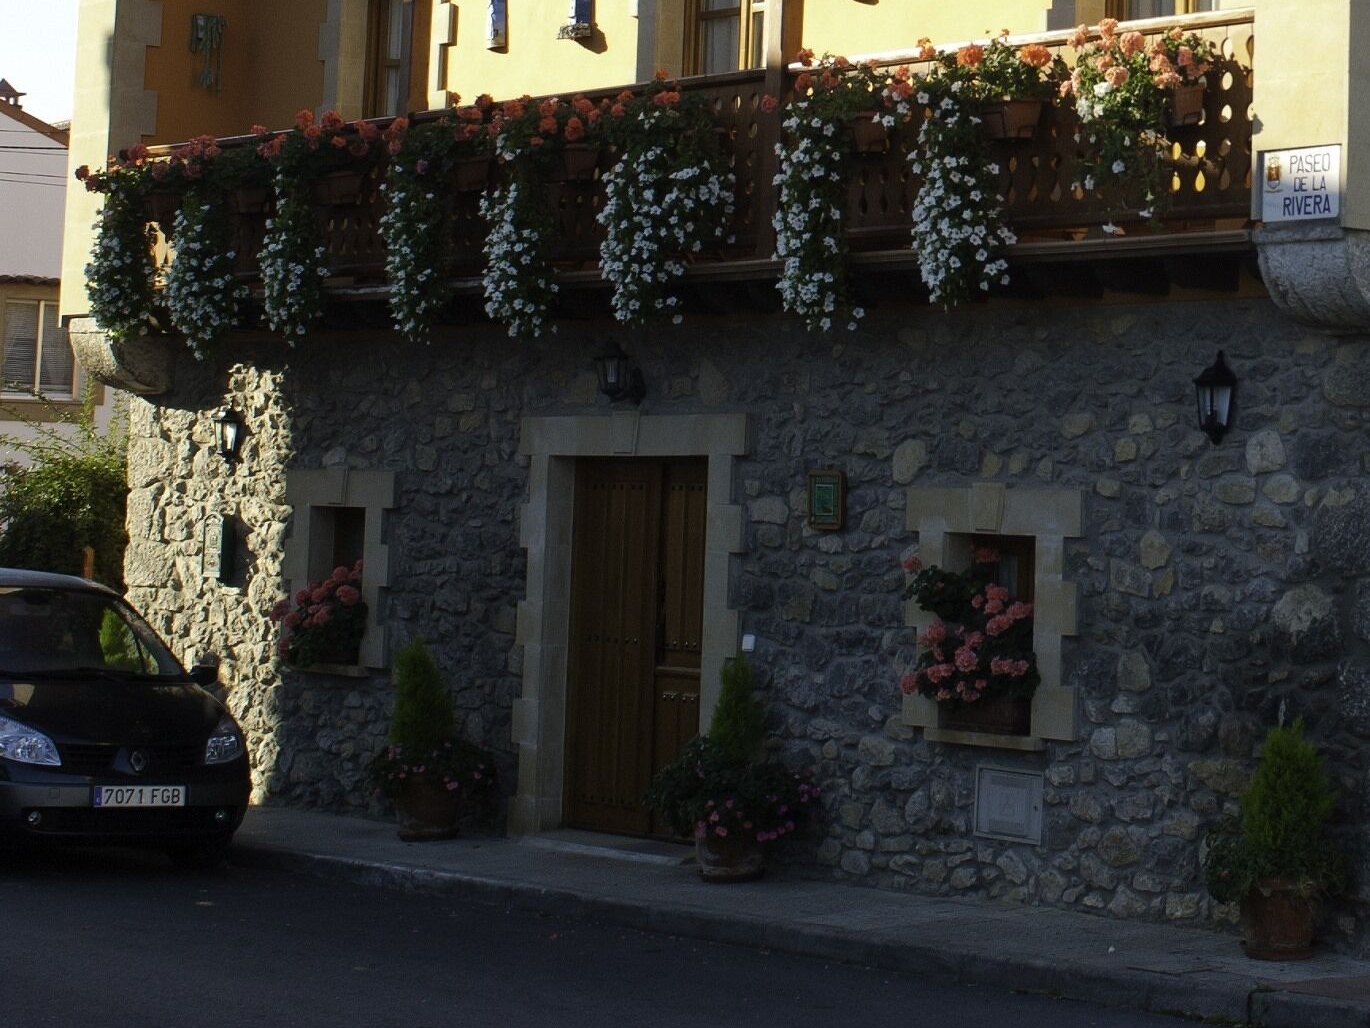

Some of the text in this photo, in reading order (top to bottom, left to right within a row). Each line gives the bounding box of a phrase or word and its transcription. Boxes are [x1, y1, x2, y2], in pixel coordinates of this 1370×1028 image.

[1289, 153, 1331, 174] PASEO
[1293, 175, 1327, 192] DE LA
[1282, 193, 1331, 217] RIVERA
[104, 788, 181, 805] 7071 FGB
